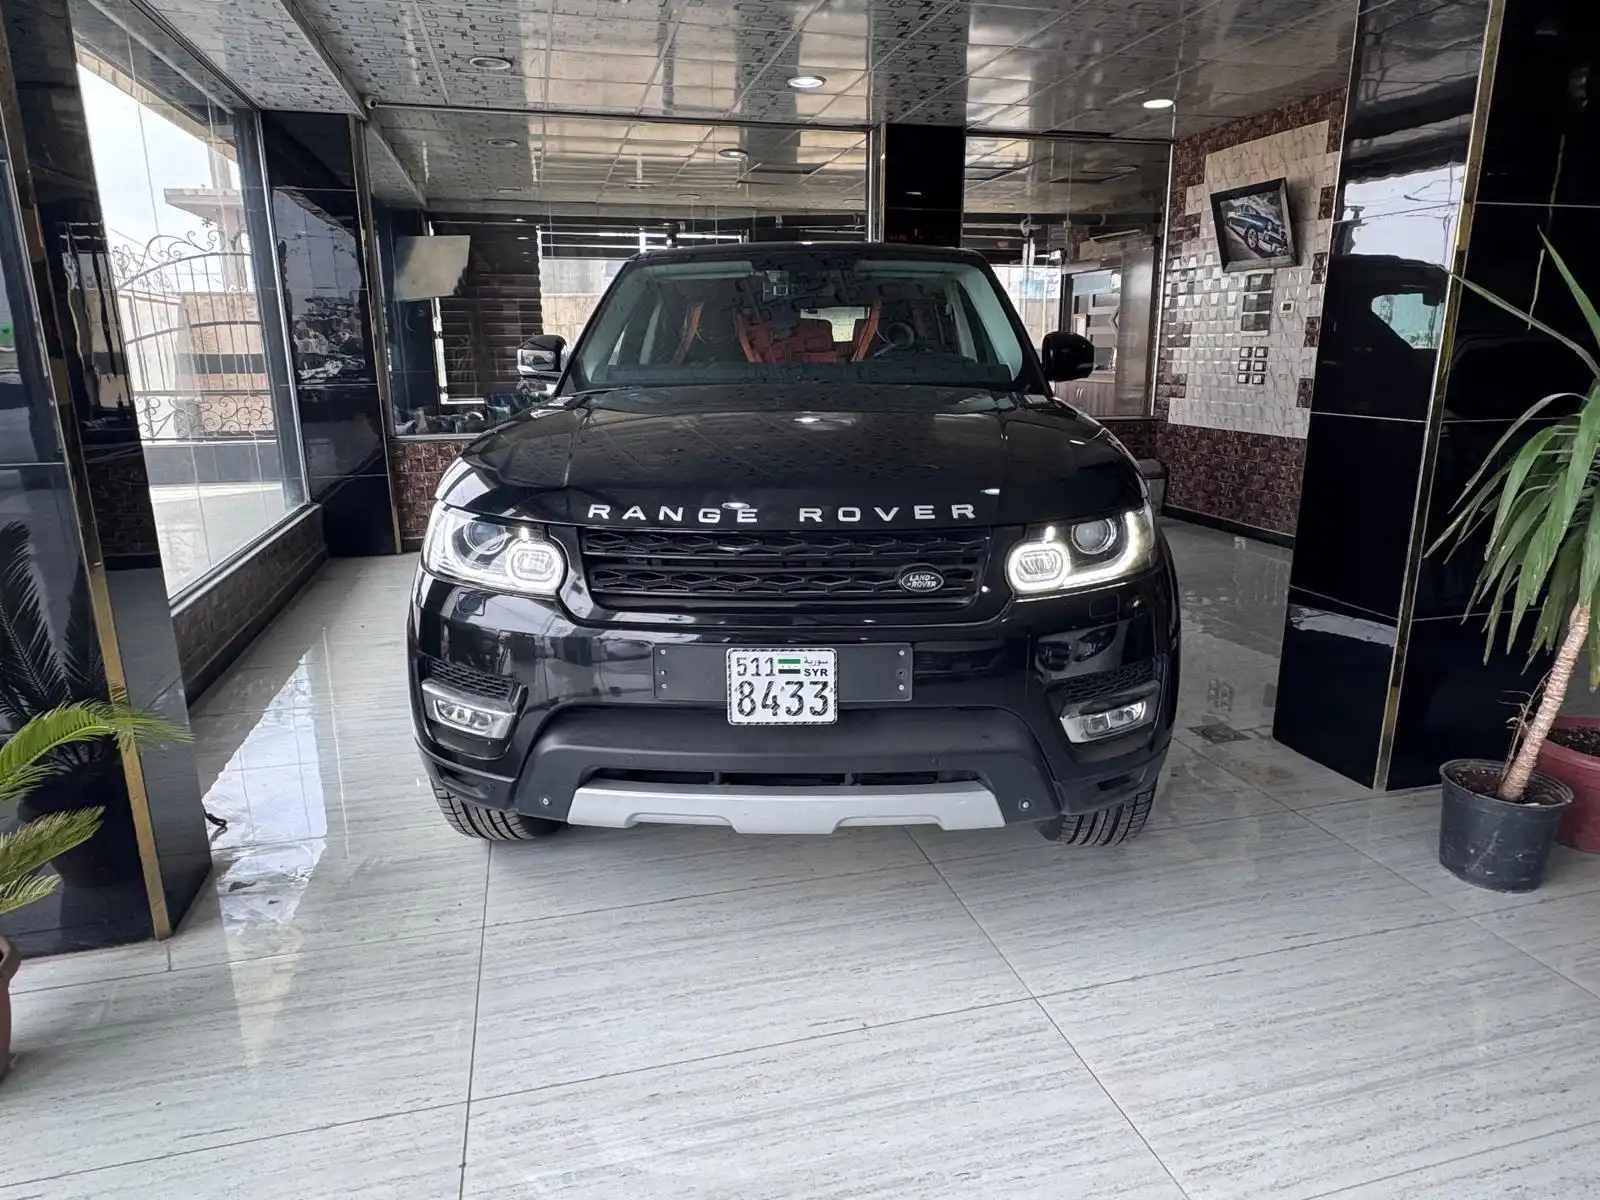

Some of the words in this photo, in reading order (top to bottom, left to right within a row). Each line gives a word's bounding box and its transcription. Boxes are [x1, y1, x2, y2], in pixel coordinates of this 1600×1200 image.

[587, 503, 759, 524] RANGE
[799, 503, 976, 523] ROVER
[736, 657, 775, 677] 511
[803, 668, 829, 677] SYR
[737, 680, 829, 717] 8433
